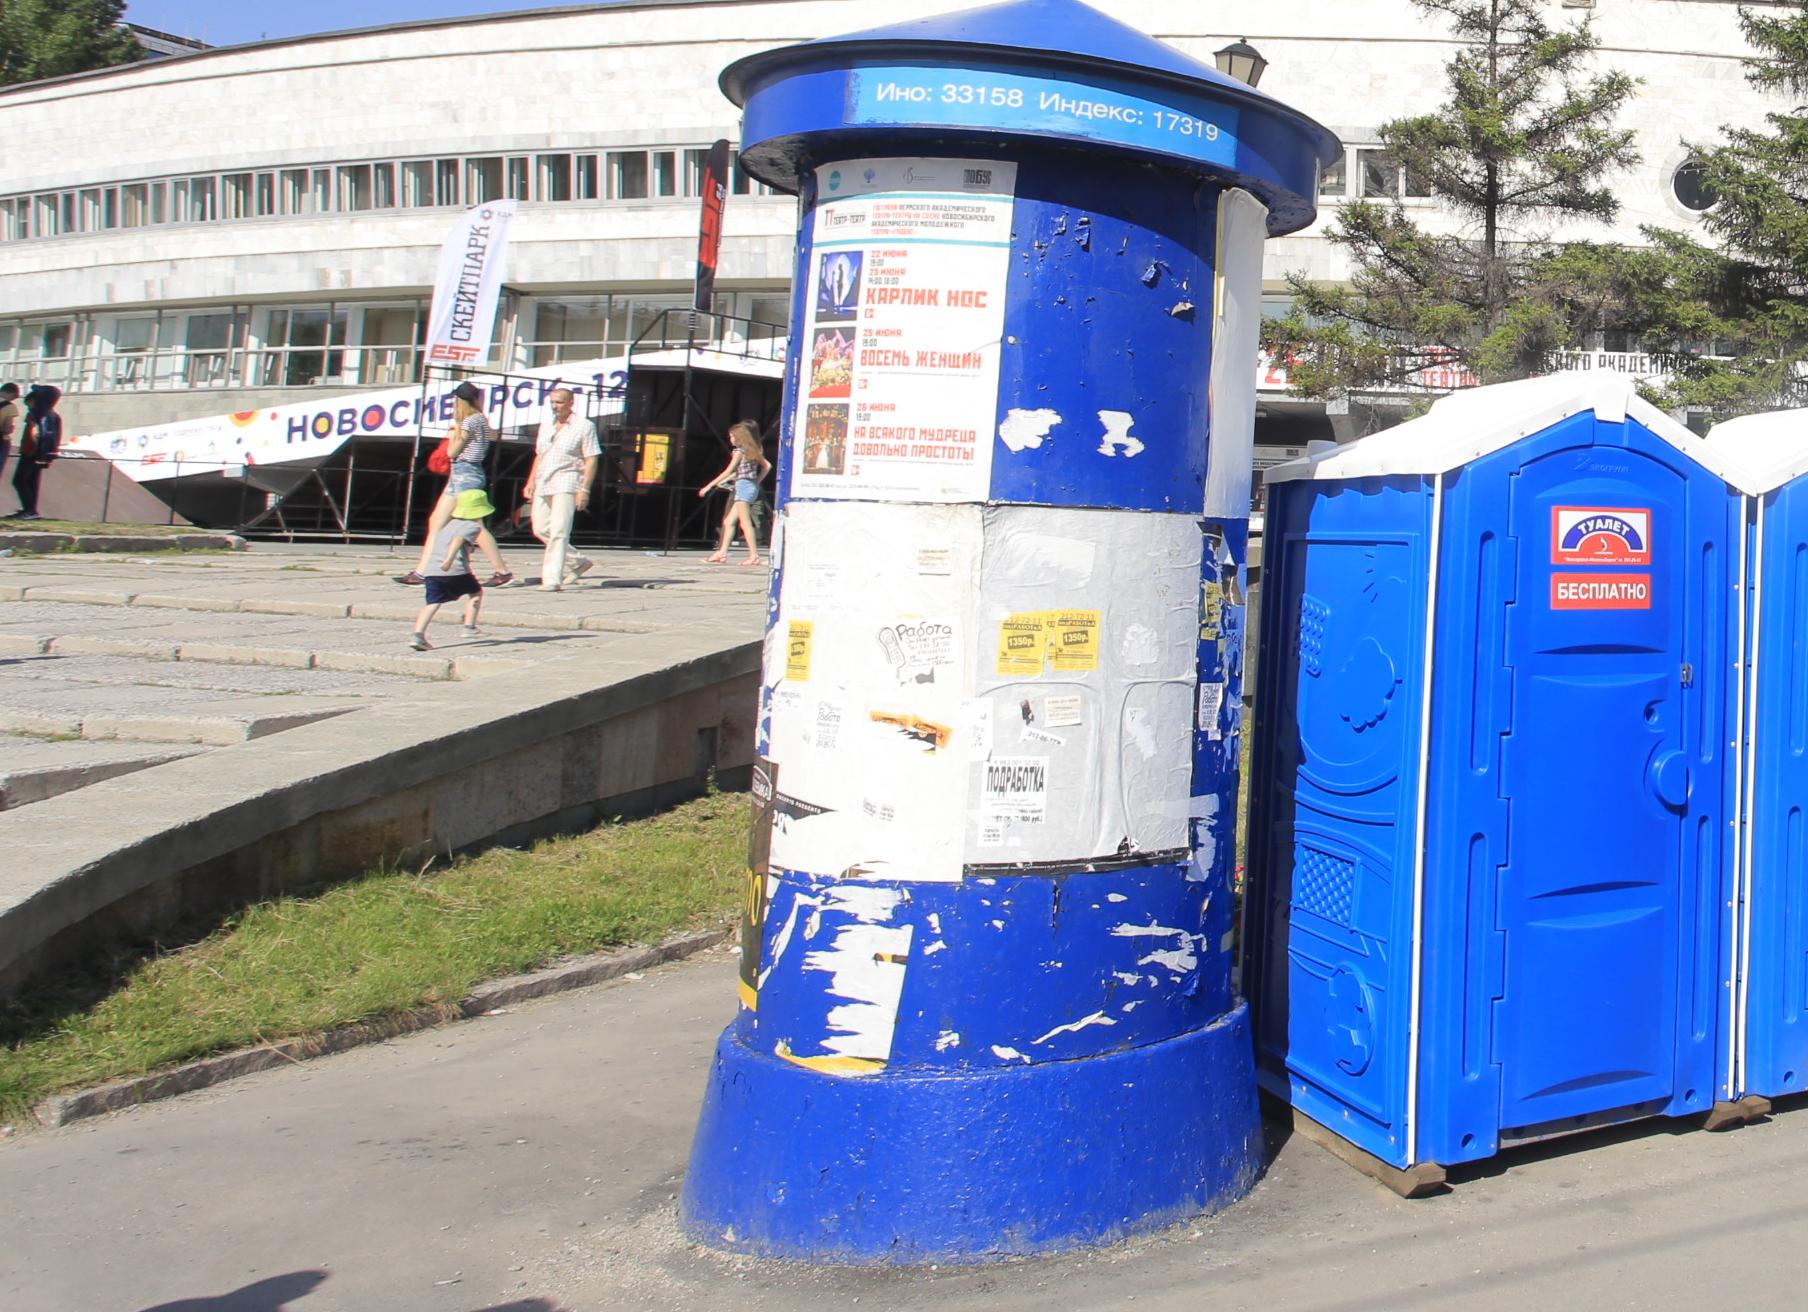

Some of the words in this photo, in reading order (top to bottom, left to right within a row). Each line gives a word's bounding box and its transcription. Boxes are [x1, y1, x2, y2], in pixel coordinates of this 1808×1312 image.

[876, 81, 933, 102] Ино:
[940, 83, 1023, 108] 33158
[1038, 91, 1144, 125] Индекс:
[1152, 110, 1219, 142] 17319
[882, 250, 908, 258] ИЮНЯ
[881, 268, 906, 276] ИЮНЯ
[450, 224, 490, 342] СКЕЙТПАРК
[865, 287, 939, 306] КАРЛИК
[946, 290, 988, 309] НОС
[875, 328, 902, 337] ИЮНЯ
[860, 349, 910, 367] ВОСЕМЬ
[915, 352, 982, 369] ЖЕНЩИН
[287, 376, 562, 443] НОВОСИБРСК
[868, 403, 896, 412] ИЮНЯ
[854, 427, 866, 439] НА
[869, 427, 915, 440] ВСЯКОГО
[919, 428, 976, 443] МУДРЕЦА
[853, 443, 907, 457] ДОВОЛЬНО
[911, 445, 974, 460] ПРОСТОТЫ
[1577, 518, 1630, 536] ТУАЛЕТ
[1557, 583, 1646, 600] БЕСПЛАТНО
[895, 621, 952, 640] Работа
[987, 765, 1045, 798] ПОДРАБОТКА
